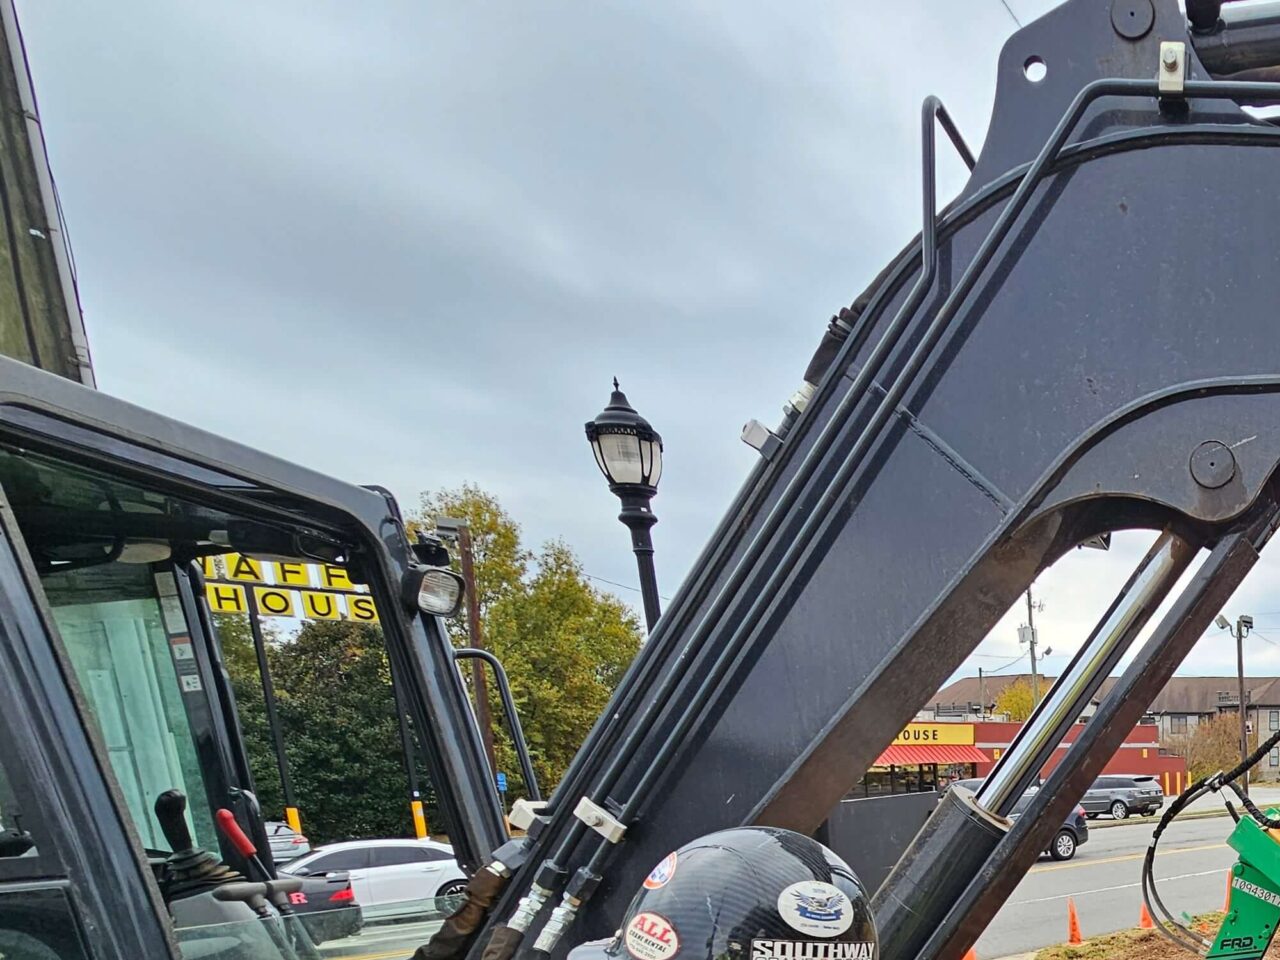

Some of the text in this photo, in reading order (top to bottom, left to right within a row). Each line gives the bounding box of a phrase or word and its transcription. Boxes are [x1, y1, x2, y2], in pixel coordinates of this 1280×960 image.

[198, 556, 346, 587] AFF
[214, 587, 376, 619] HOUS
[288, 891, 308, 905] R
[633, 915, 672, 945] ALL
[752, 940, 876, 958] SOUTHWAY
